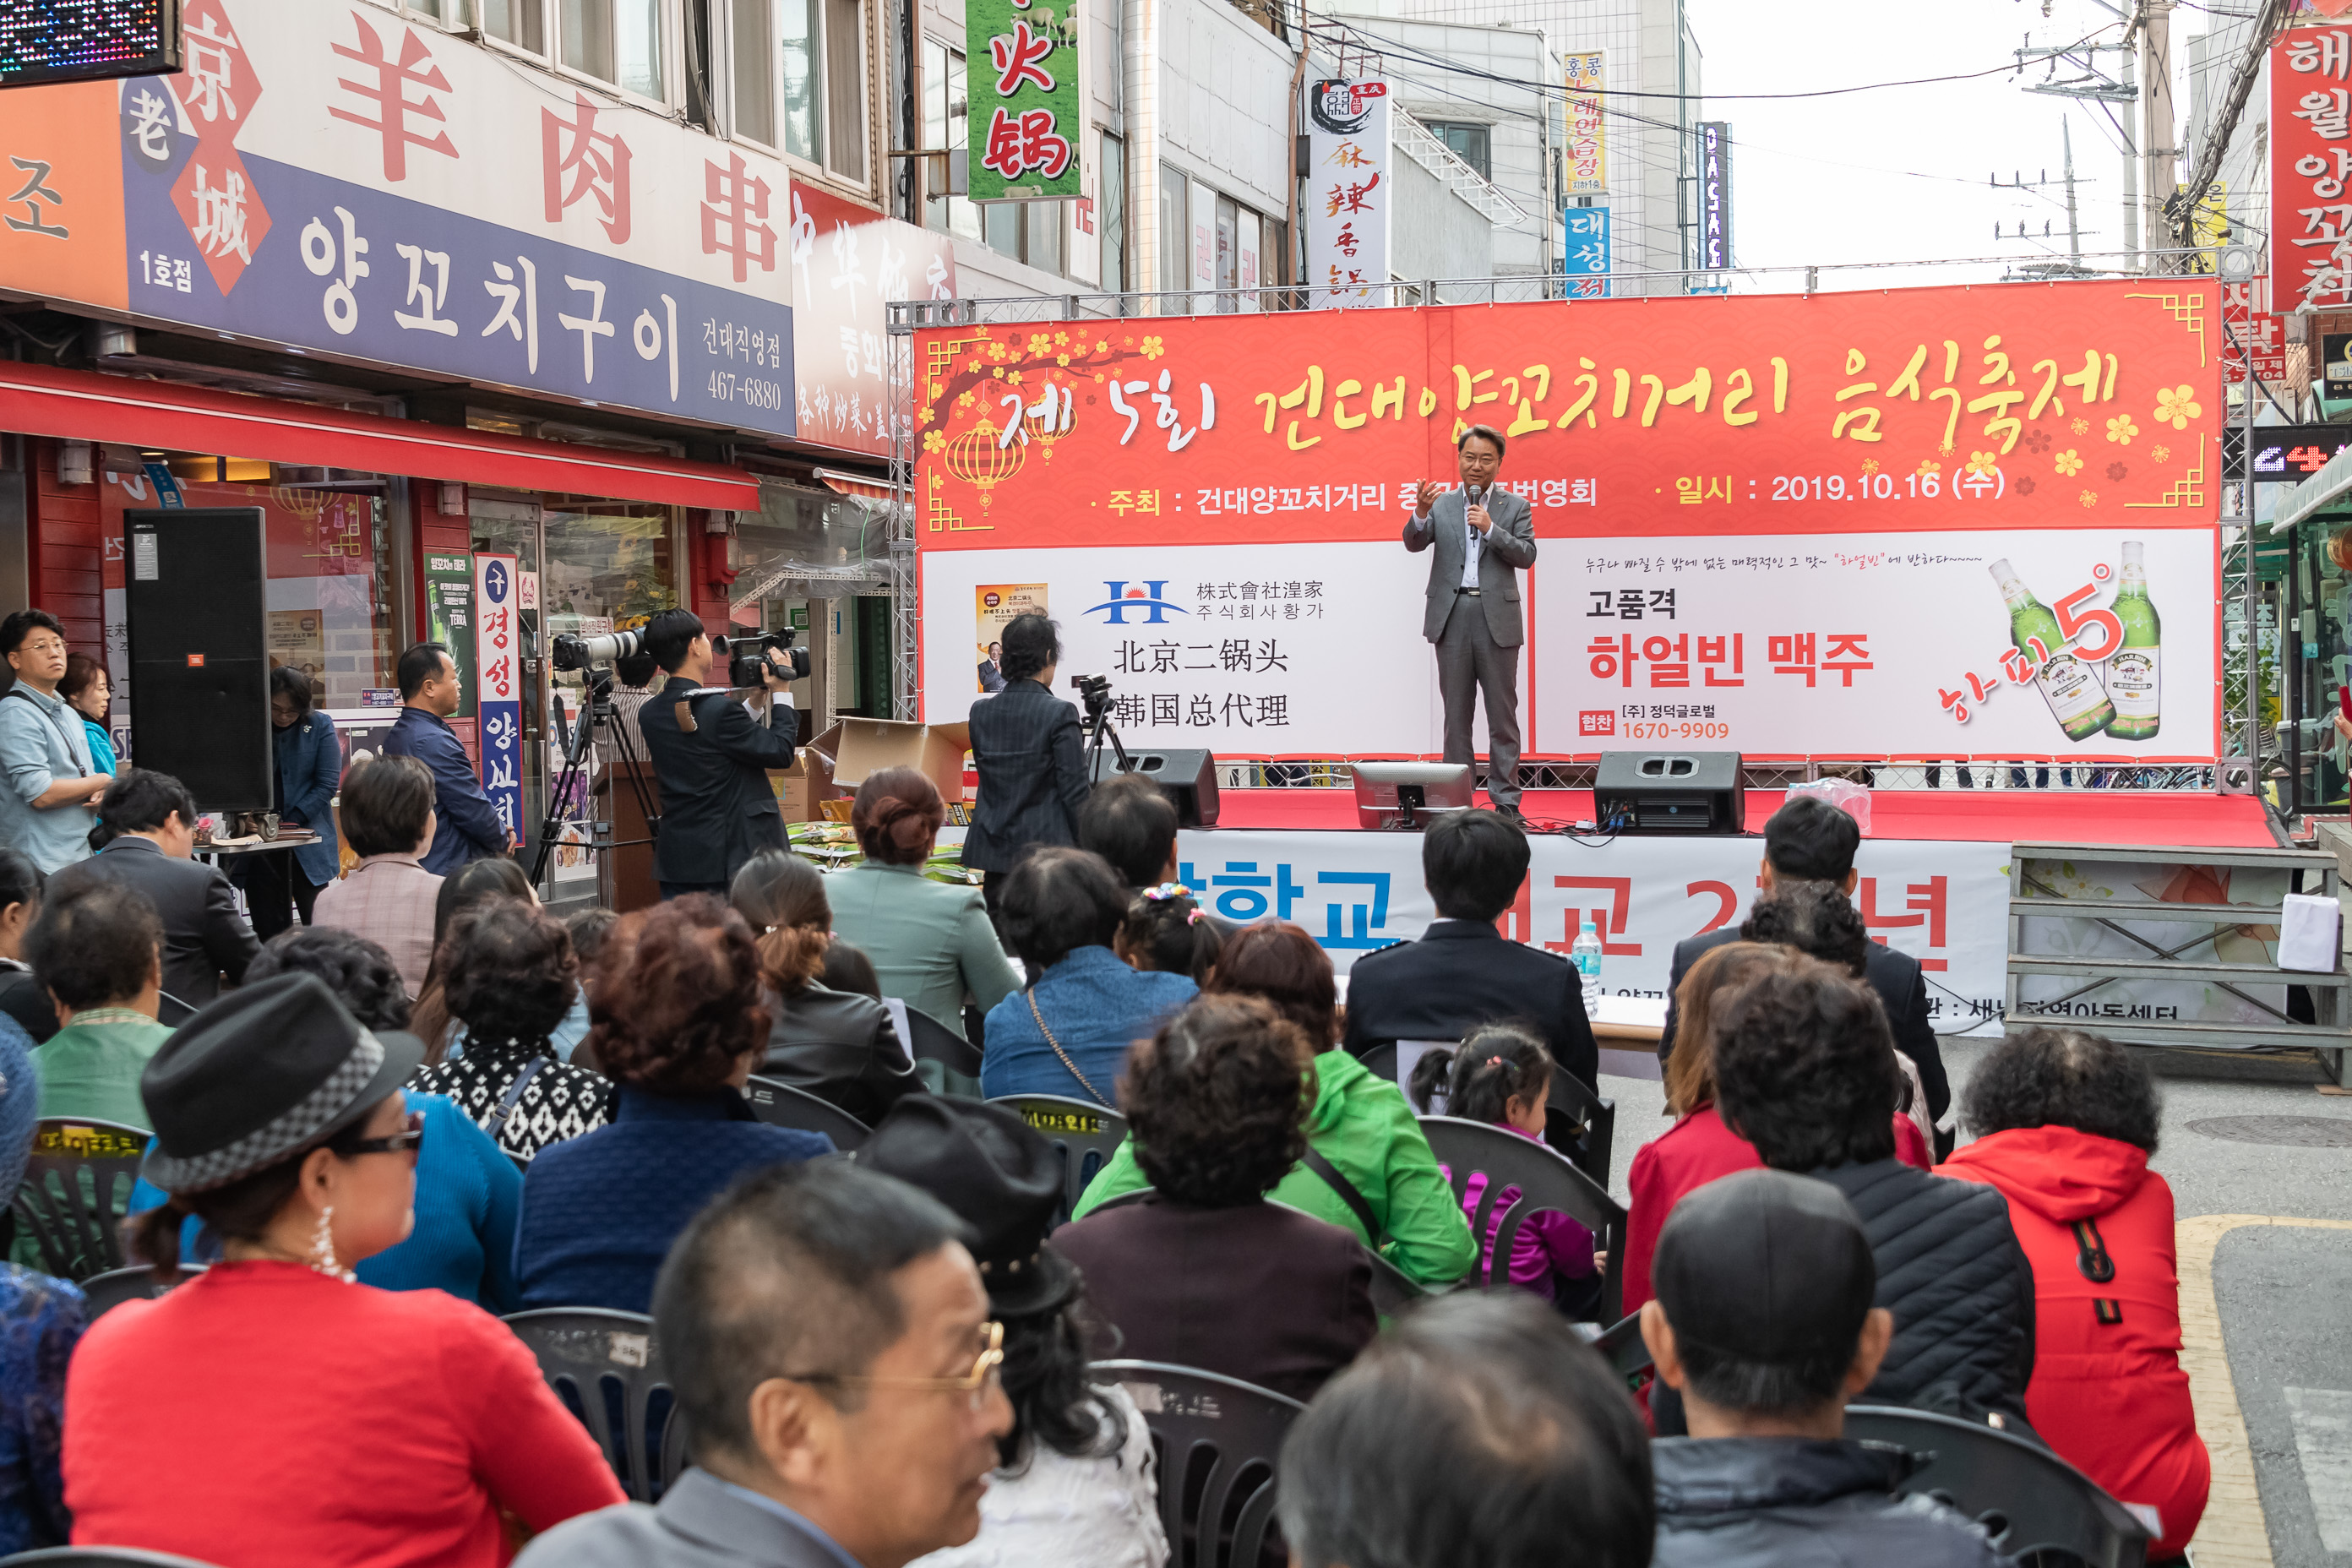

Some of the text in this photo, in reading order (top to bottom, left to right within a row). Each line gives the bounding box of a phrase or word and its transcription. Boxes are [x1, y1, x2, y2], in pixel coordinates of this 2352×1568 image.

[1565, 57, 1602, 77] 홍콩
[1355, 84, 1382, 95] 重庆
[129, 90, 172, 161] 老
[184, 9, 252, 265] 京城
[1573, 79, 1602, 177] 노래연습장
[327, 10, 778, 283] 羊肉串
[3, 155, 69, 240] 조
[1572, 179, 1601, 190] 지하1층
[140, 250, 192, 294] 1호점
[300, 205, 679, 403] 양꼬치구이
[702, 318, 781, 369] 건대직영점
[708, 370, 781, 411] 467-6880
[999, 335, 2120, 457] 제 5회 건대양꼬치거리 음식축제
[1108, 487, 1162, 519] 주최
[1196, 482, 1387, 517] 건대양꼬치거리
[1675, 473, 1734, 506] 일시
[1772, 471, 1941, 504] 2019.10.16
[1952, 467, 2006, 501] (수)
[487, 567, 506, 596] 구
[1585, 558, 1620, 574] 누구나
[1624, 557, 1652, 573] 빠질
[1656, 556, 1665, 573] 수
[1703, 556, 1727, 571] 없는
[1732, 556, 1783, 571] 매력적인
[1789, 557, 1799, 568] 그
[449, 613, 467, 627] TERRA
[1586, 587, 1677, 621] 고품격
[483, 606, 510, 698] 경성
[1113, 638, 1289, 674] 北京二锅头
[1587, 631, 1875, 689] 하얼빈 맥주
[2043, 655, 2070, 672] HARBIN
[2118, 654, 2147, 663] HARBIN
[1113, 693, 1290, 728] 韩国总代理
[1582, 714, 1613, 732] 협찬
[1622, 705, 1716, 719] [주] 정덕글로벌
[1622, 722, 1729, 739] 1670-9909
[1686, 875, 1948, 972] 2년
